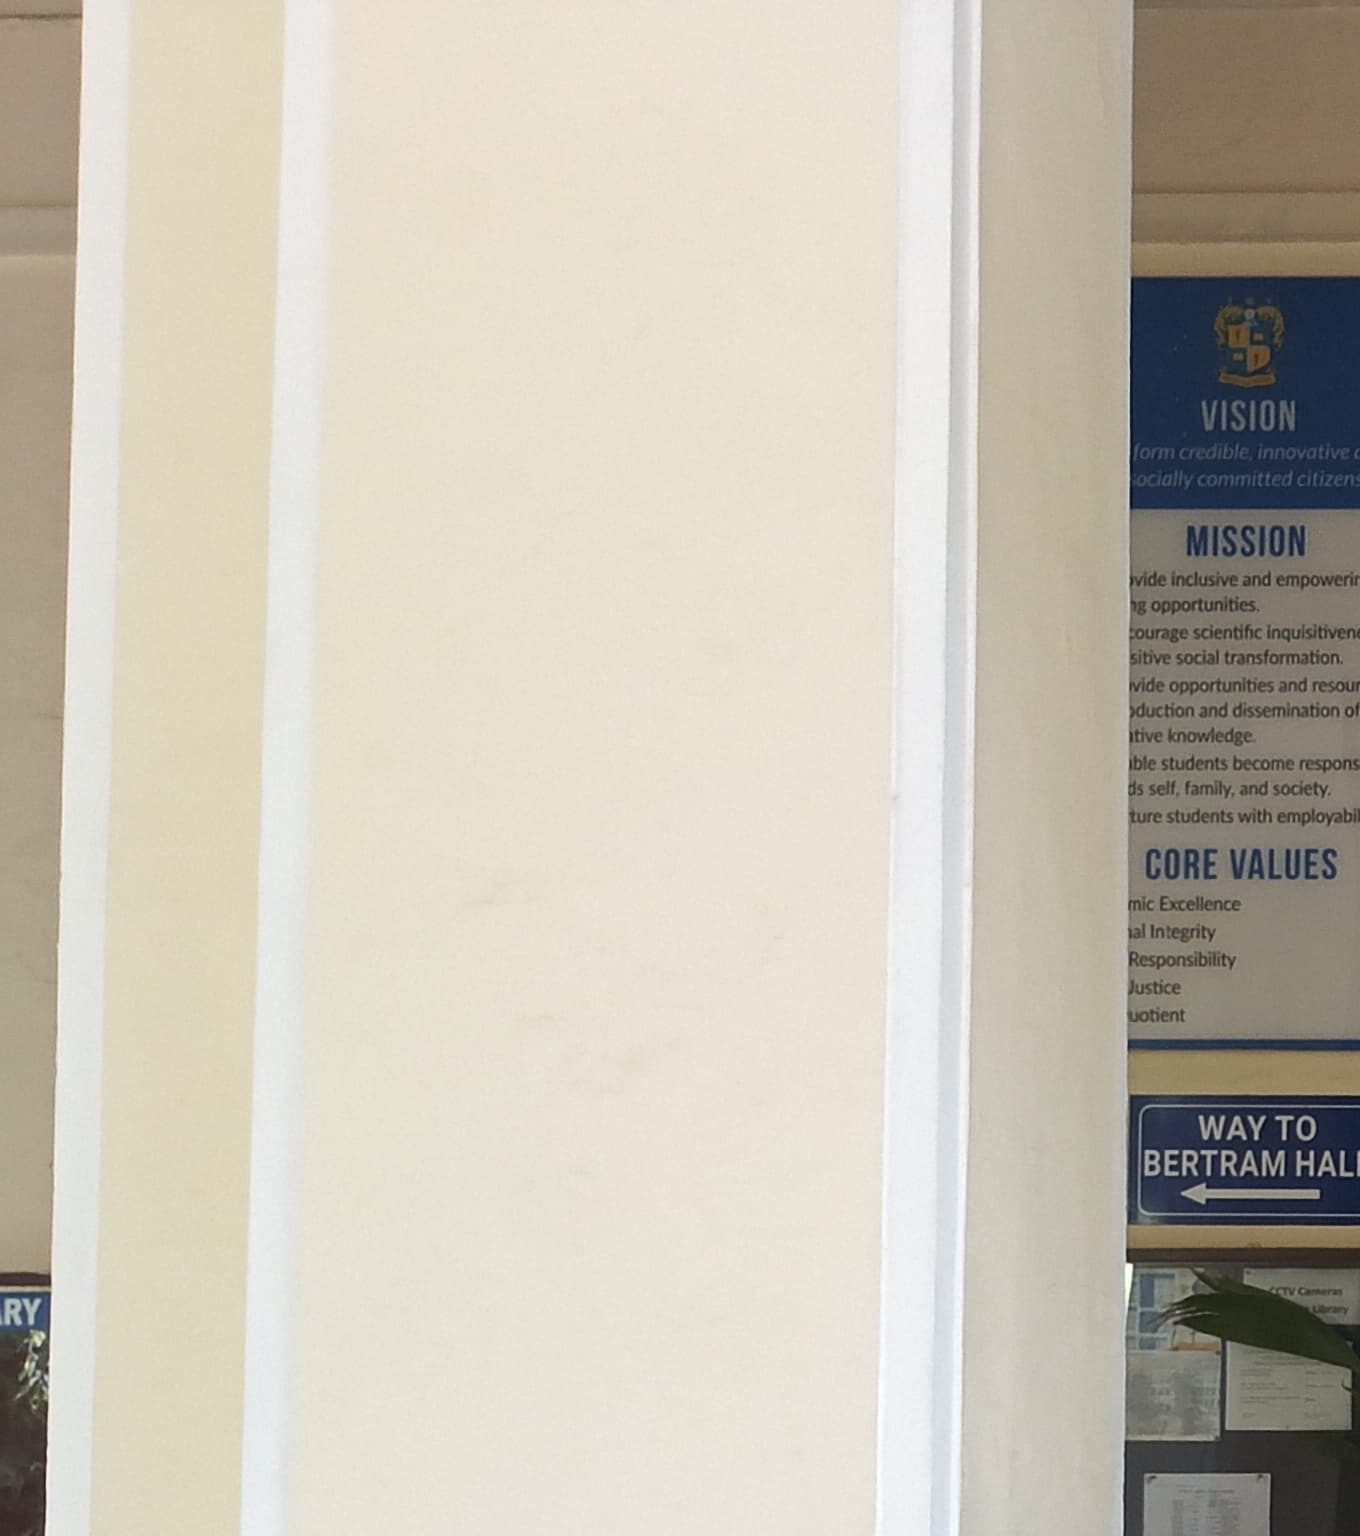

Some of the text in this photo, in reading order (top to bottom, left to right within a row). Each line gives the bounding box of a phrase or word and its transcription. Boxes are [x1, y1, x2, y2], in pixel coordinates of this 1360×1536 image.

[1201, 400, 1296, 432] VISION
[1133, 443, 1174, 461] form
[1178, 443, 1252, 462] credible,
[1258, 443, 1350, 460] innovative
[1198, 470, 1292, 488] committed
[1186, 524, 1306, 557] MISSION
[1171, 572, 1238, 588] inclusive
[1242, 572, 1272, 588] and
[1151, 596, 1259, 616] opportunities.
[1193, 624, 1262, 640] scientific
[1176, 650, 1220, 665] social
[1224, 650, 1343, 665] transformation.
[1170, 678, 1274, 696] opportunities
[1278, 678, 1308, 693] and
[1199, 702, 1228, 718] and
[1232, 702, 1340, 718] dissemination
[1344, 702, 1360, 718] of
[1168, 727, 1256, 746] knowledge.
[1161, 756, 1228, 770] students
[1233, 756, 1294, 770] become
[1149, 782, 1180, 798] self,
[1184, 782, 1235, 799] family,
[1239, 782, 1268, 796] and
[1272, 782, 1332, 799] society.
[1166, 808, 1234, 824] students
[1238, 808, 1272, 824] with
[1145, 848, 1338, 880] CORE VALUES
[1160, 896, 1242, 912] Excellence
[1150, 924, 1216, 942] Integrity
[1129, 952, 1236, 970] Responsibility
[1128, 980, 1182, 996] Justice
[1198, 1115, 1317, 1141] WAY TO
[1144, 1149, 1285, 1177] BERTRAM
[1298, 1286, 1343, 1296] Cameras
[0, 1298, 42, 1326] RY
[1312, 1304, 1349, 1315] Library
